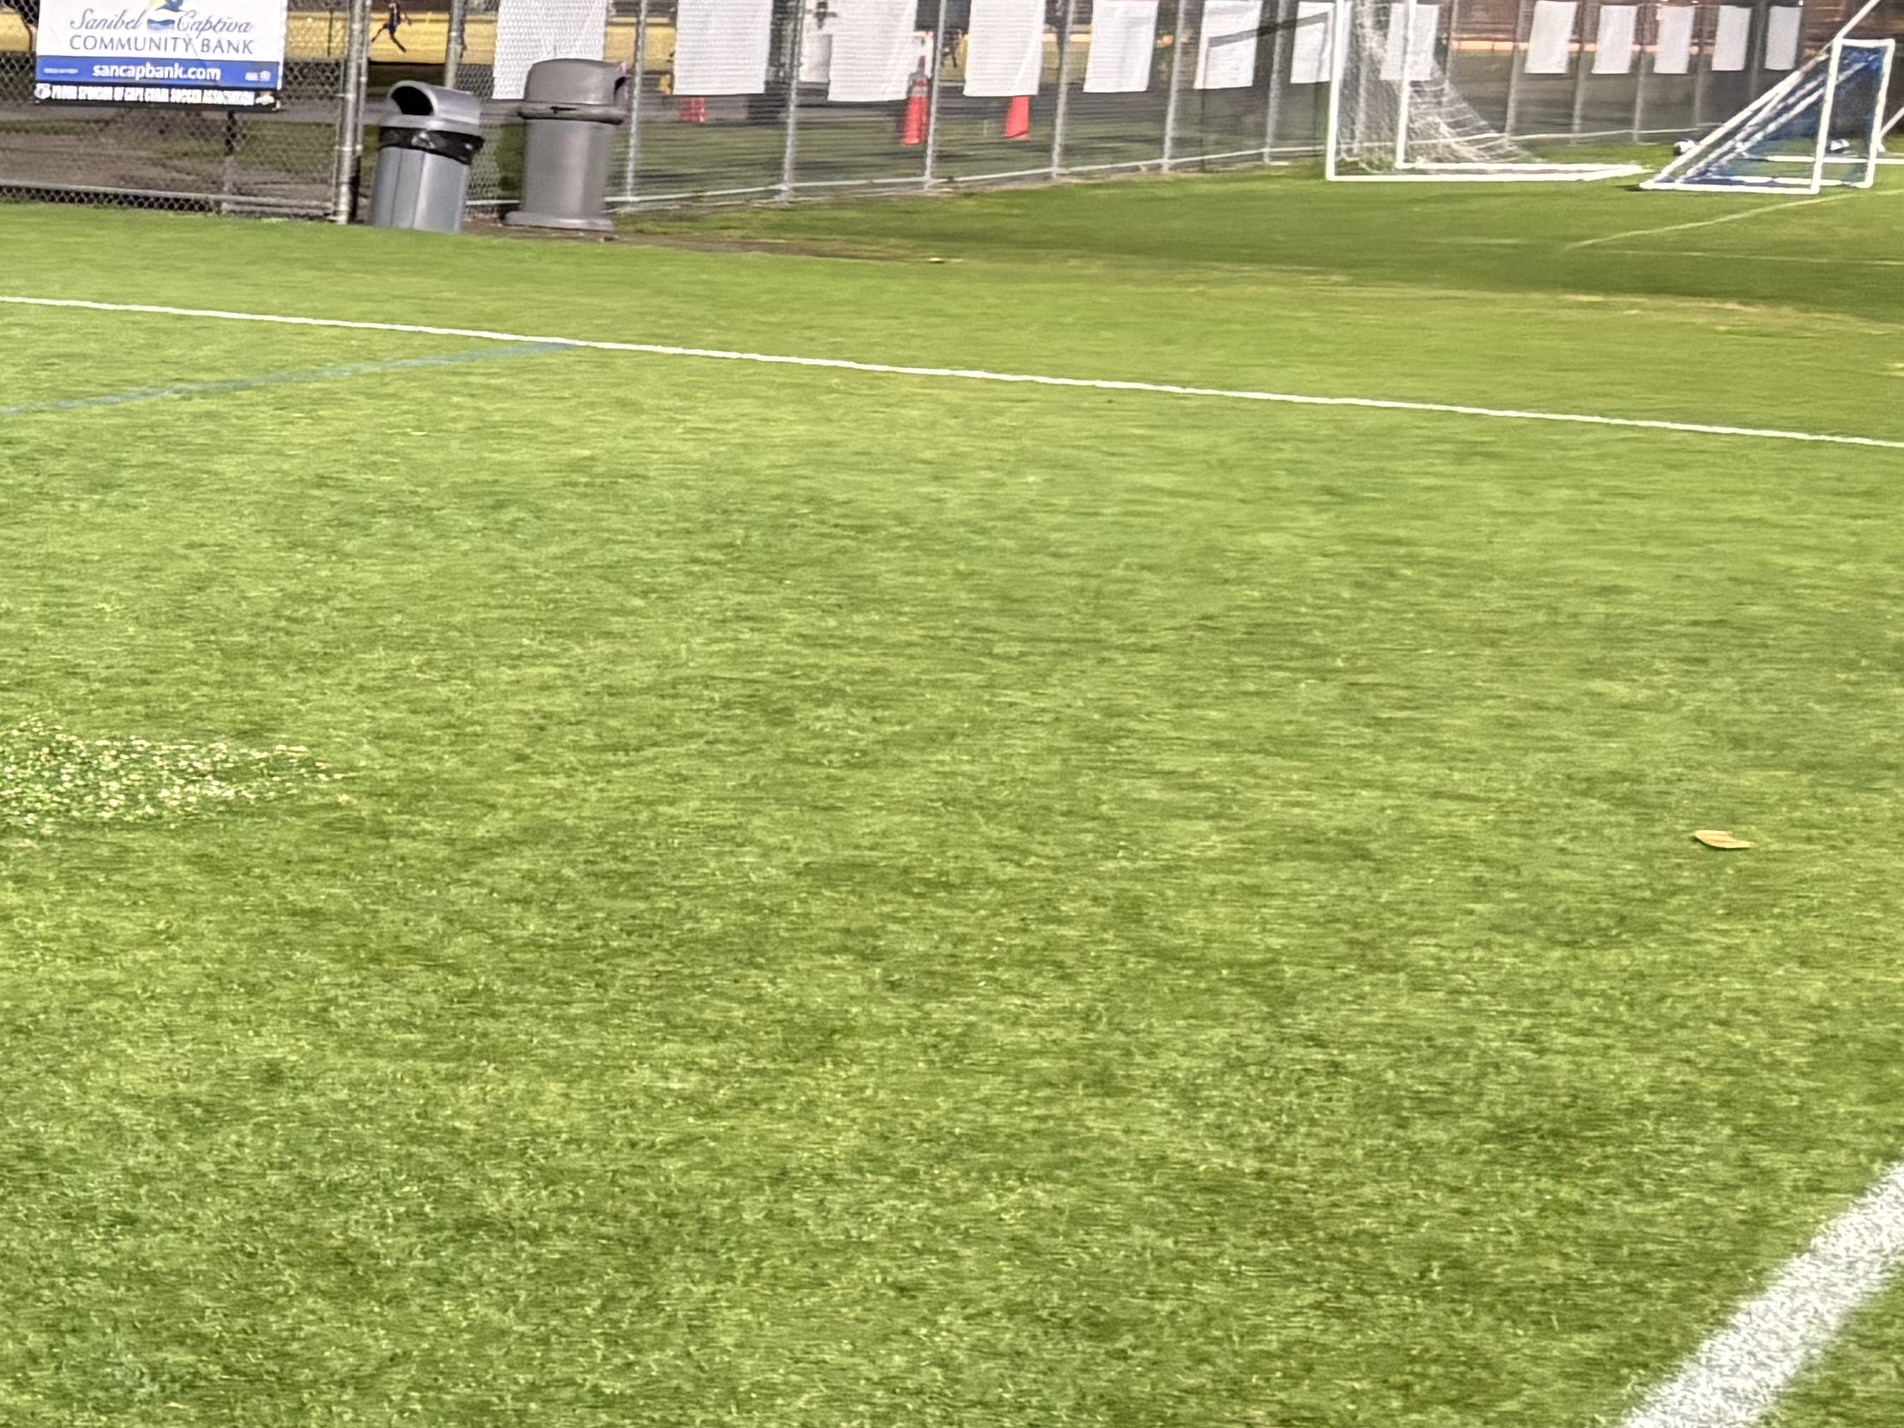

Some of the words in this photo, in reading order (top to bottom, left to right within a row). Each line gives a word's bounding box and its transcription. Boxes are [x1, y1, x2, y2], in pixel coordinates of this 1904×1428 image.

[70, 8, 143, 31] Sanibel
[175, 10, 254, 38] Captiva
[69, 35, 192, 53] COMMUNITY
[200, 38, 254, 55] BANK
[92, 62, 222, 81] sancapbank.com
